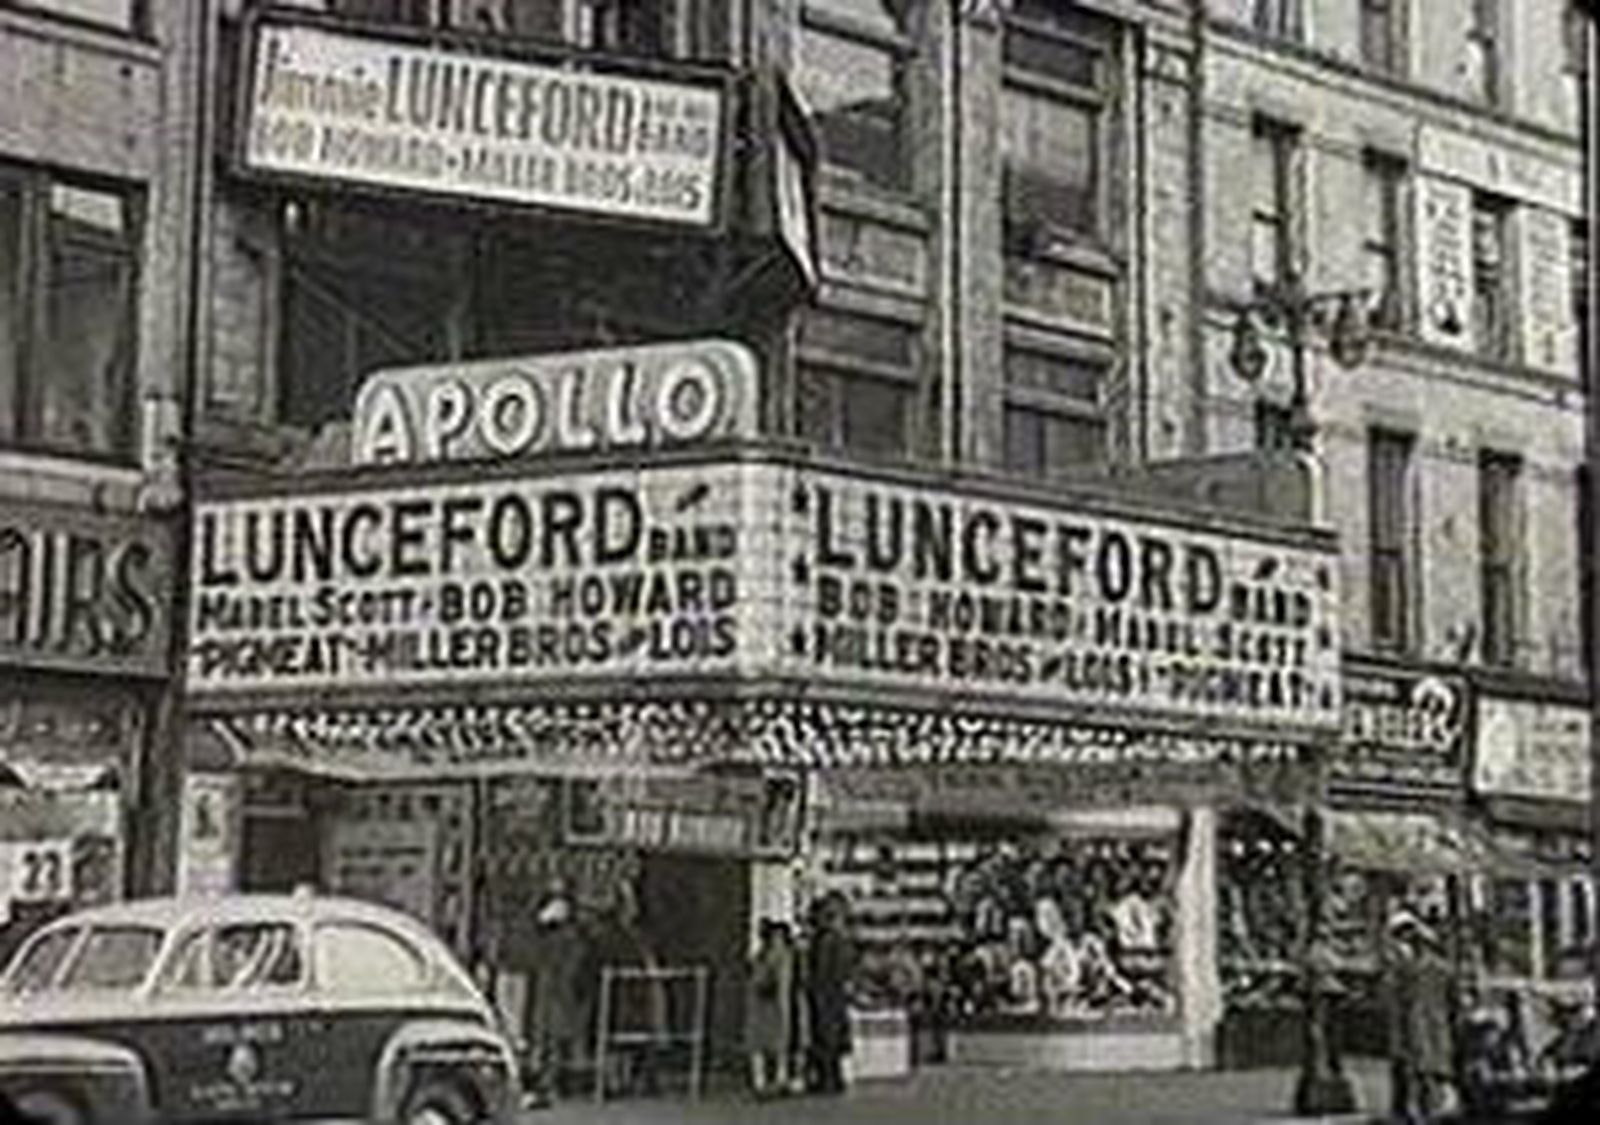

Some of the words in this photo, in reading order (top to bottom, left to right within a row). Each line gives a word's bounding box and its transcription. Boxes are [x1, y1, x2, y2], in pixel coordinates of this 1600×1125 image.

[386, 55, 634, 154] LUNCEFORD
[364, 361, 722, 464] APOLLO
[199, 486, 643, 586] LUNCEFORD
[813, 484, 1222, 616] LUNCEFORD
[438, 581, 528, 625] BOB
[549, 568, 737, 617] HOWARD
[506, 621, 613, 668] BROS
[650, 615, 737, 661] LOIS
[816, 573, 899, 626] BOB
